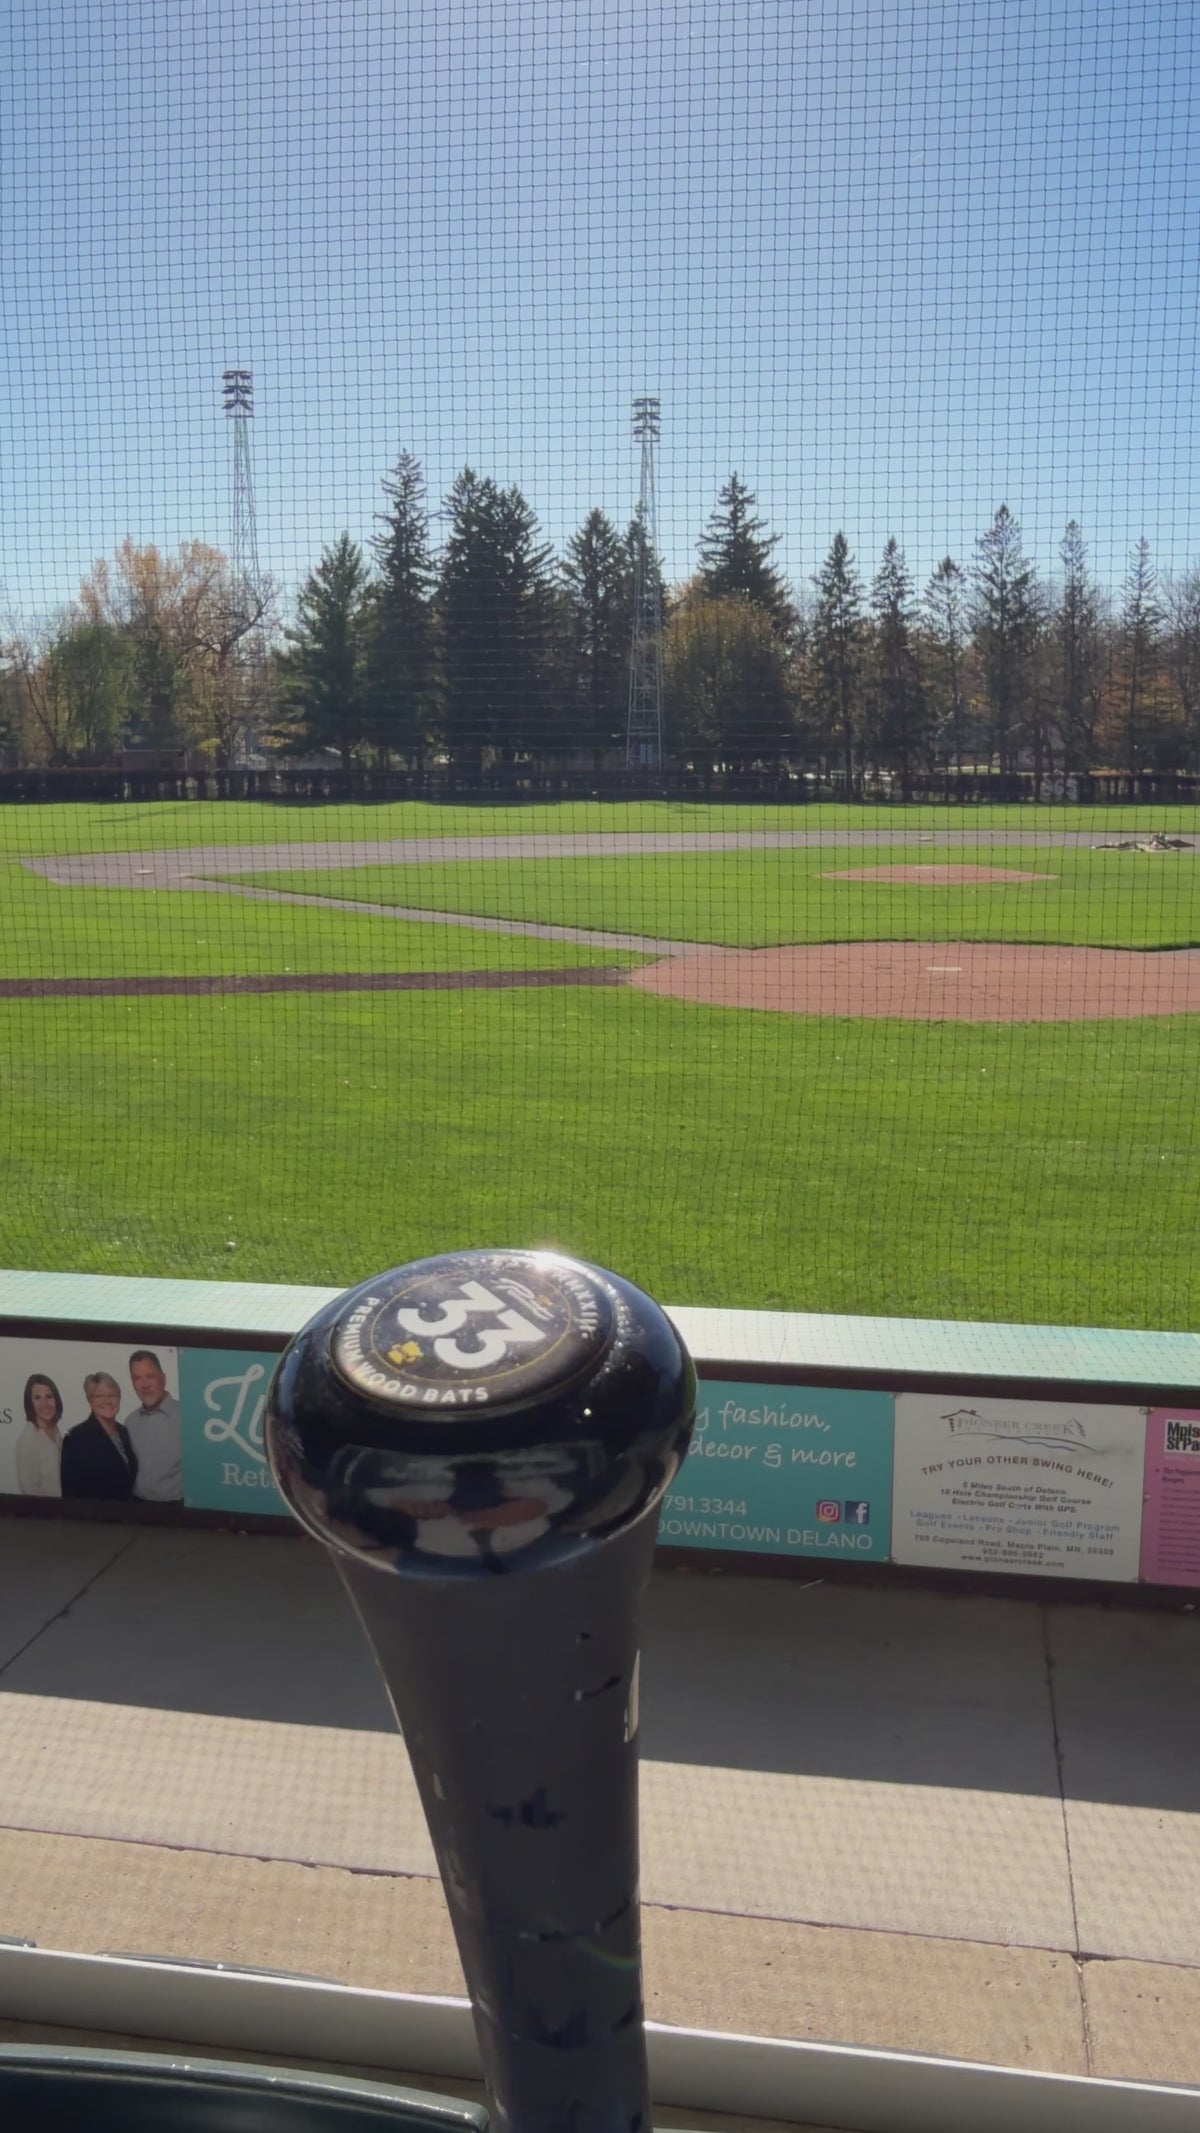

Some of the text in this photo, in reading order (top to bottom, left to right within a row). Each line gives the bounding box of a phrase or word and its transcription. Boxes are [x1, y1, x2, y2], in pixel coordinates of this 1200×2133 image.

[397, 1280, 546, 1370] 33
[342, 1297, 489, 1403] PREMIUM WOOD BATS
[718, 1400, 831, 1432] fashion,
[688, 1435, 757, 1459] decor
[791, 1449, 856, 1467] more
[221, 1462, 277, 1488] Ret
[921, 1455, 1114, 1489] TRY YOUR OTHER SWING HERE!
[953, 1490, 972, 1498] Hole
[975, 1491, 1037, 1501] Championship
[1040, 1495, 1057, 1503] Golf
[1061, 1497, 1091, 1505] Course
[970, 1482, 993, 1490] Miles
[952, 1498, 985, 1507] Electric
[1008, 1502, 1031, 1510] Crts
[916, 1519, 937, 1527] Golf
[1043, 1528, 1085, 1540] Friendly
[1088, 1532, 1114, 1540] Staff
[1077, 1522, 1120, 1532] Program
[787, 1529, 872, 1549] DELANO
